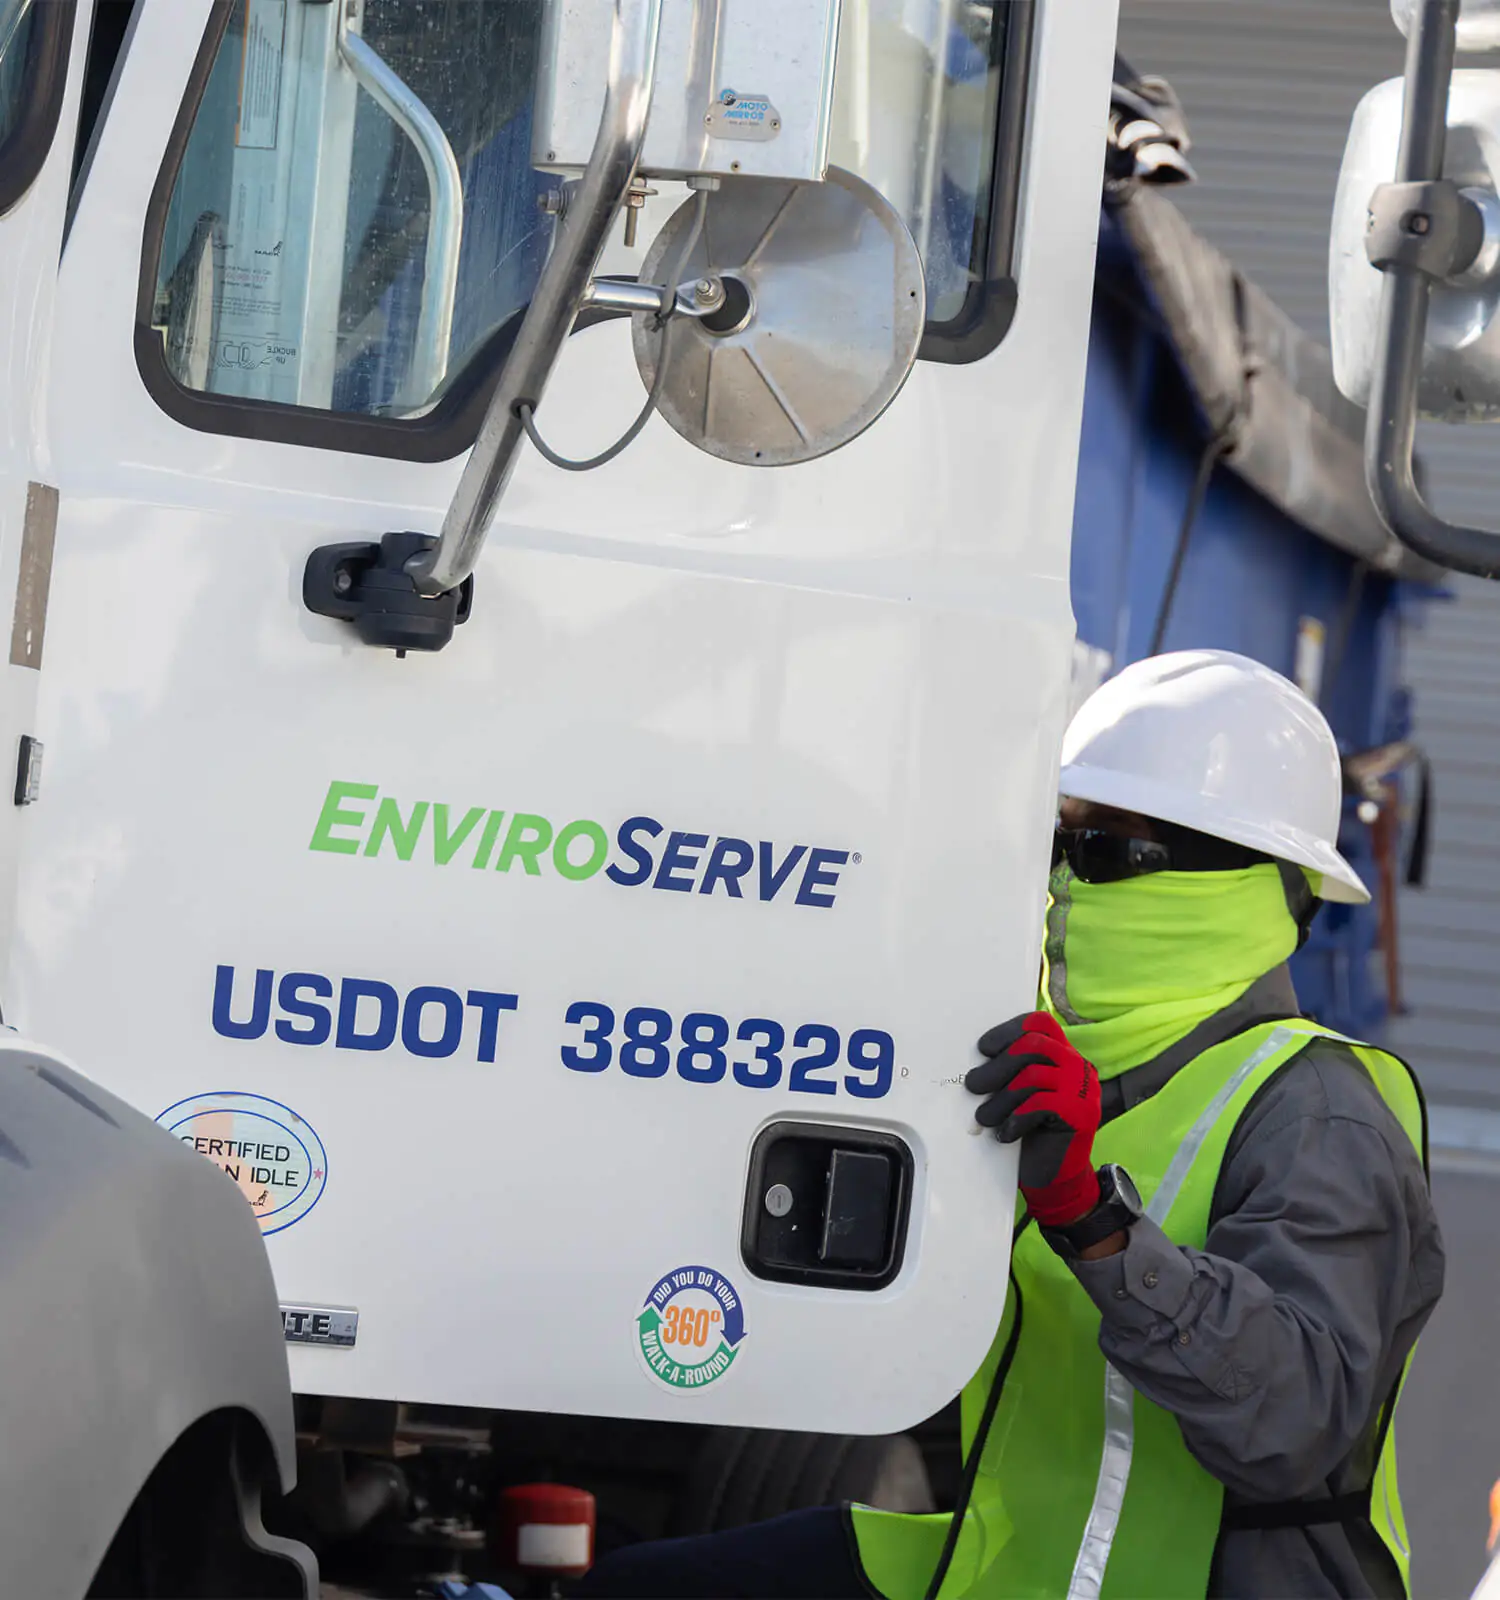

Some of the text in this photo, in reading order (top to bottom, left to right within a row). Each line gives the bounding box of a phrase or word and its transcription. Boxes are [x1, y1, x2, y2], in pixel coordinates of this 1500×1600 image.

[212, 964, 895, 1099] USDOT 388329
[250, 1167, 299, 1187] IDLE
[653, 1271, 737, 1311] DID YOU DO YOUR
[641, 1329, 729, 1385] WALK-A-ROUND
